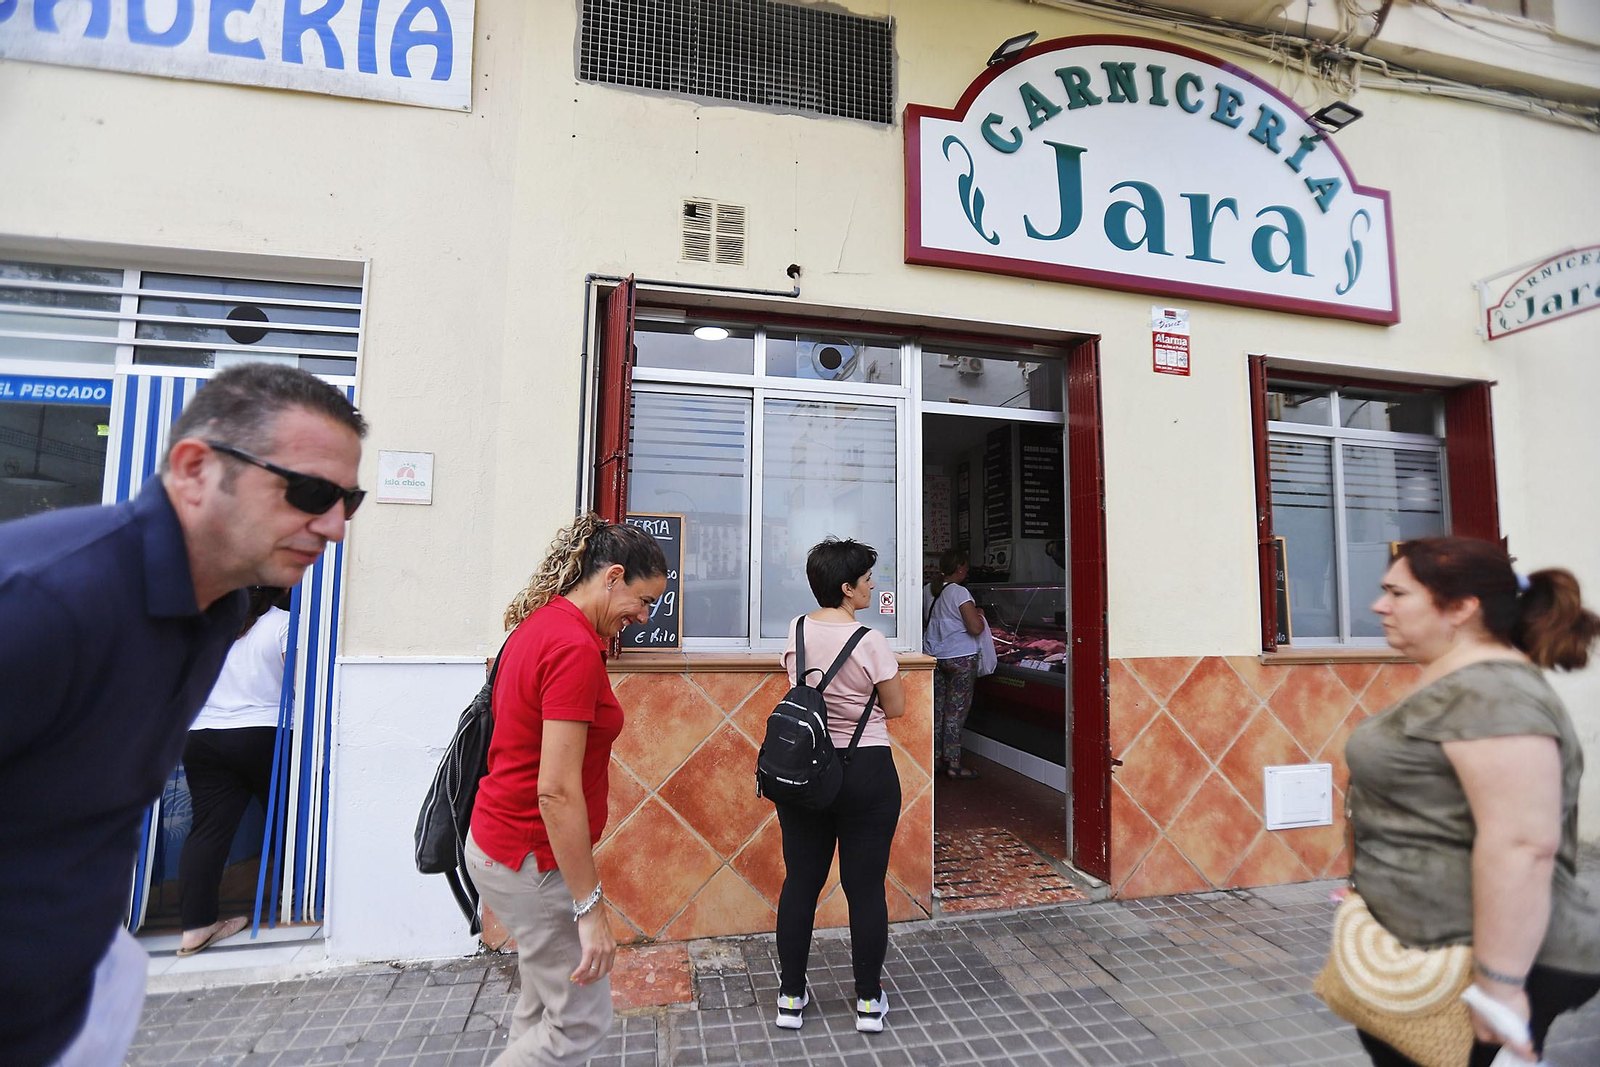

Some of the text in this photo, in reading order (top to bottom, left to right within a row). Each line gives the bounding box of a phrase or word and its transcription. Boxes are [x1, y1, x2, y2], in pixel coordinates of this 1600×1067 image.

[1022, 139, 1316, 278] Jara
[1504, 250, 1600, 309] CARNICE
[1155, 333, 1188, 346] Alarma
[20, 383, 106, 400] PESCADO
[402, 479, 426, 487] chica
